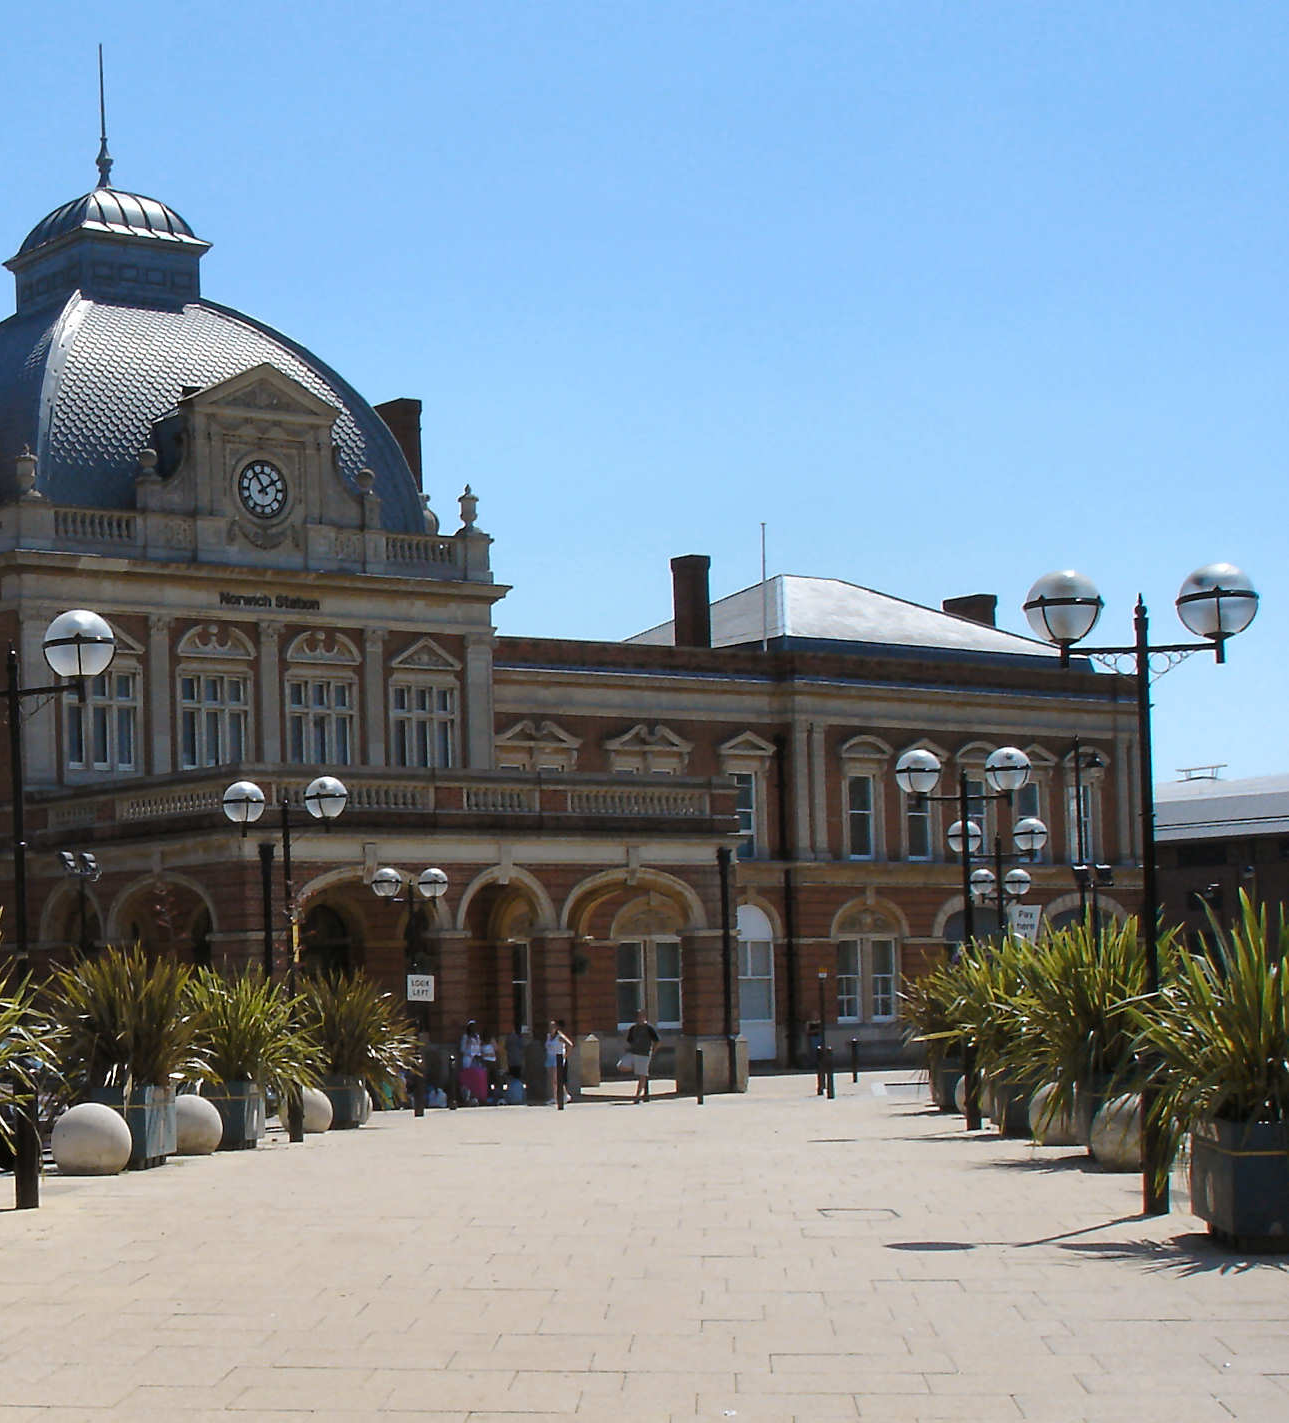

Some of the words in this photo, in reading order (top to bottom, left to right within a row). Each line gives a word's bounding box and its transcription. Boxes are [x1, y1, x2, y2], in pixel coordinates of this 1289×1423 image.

[219, 591, 271, 607] Norwich
[275, 594, 320, 610] Station
[411, 979, 430, 987] LOOK
[412, 989, 429, 997] LEFT
